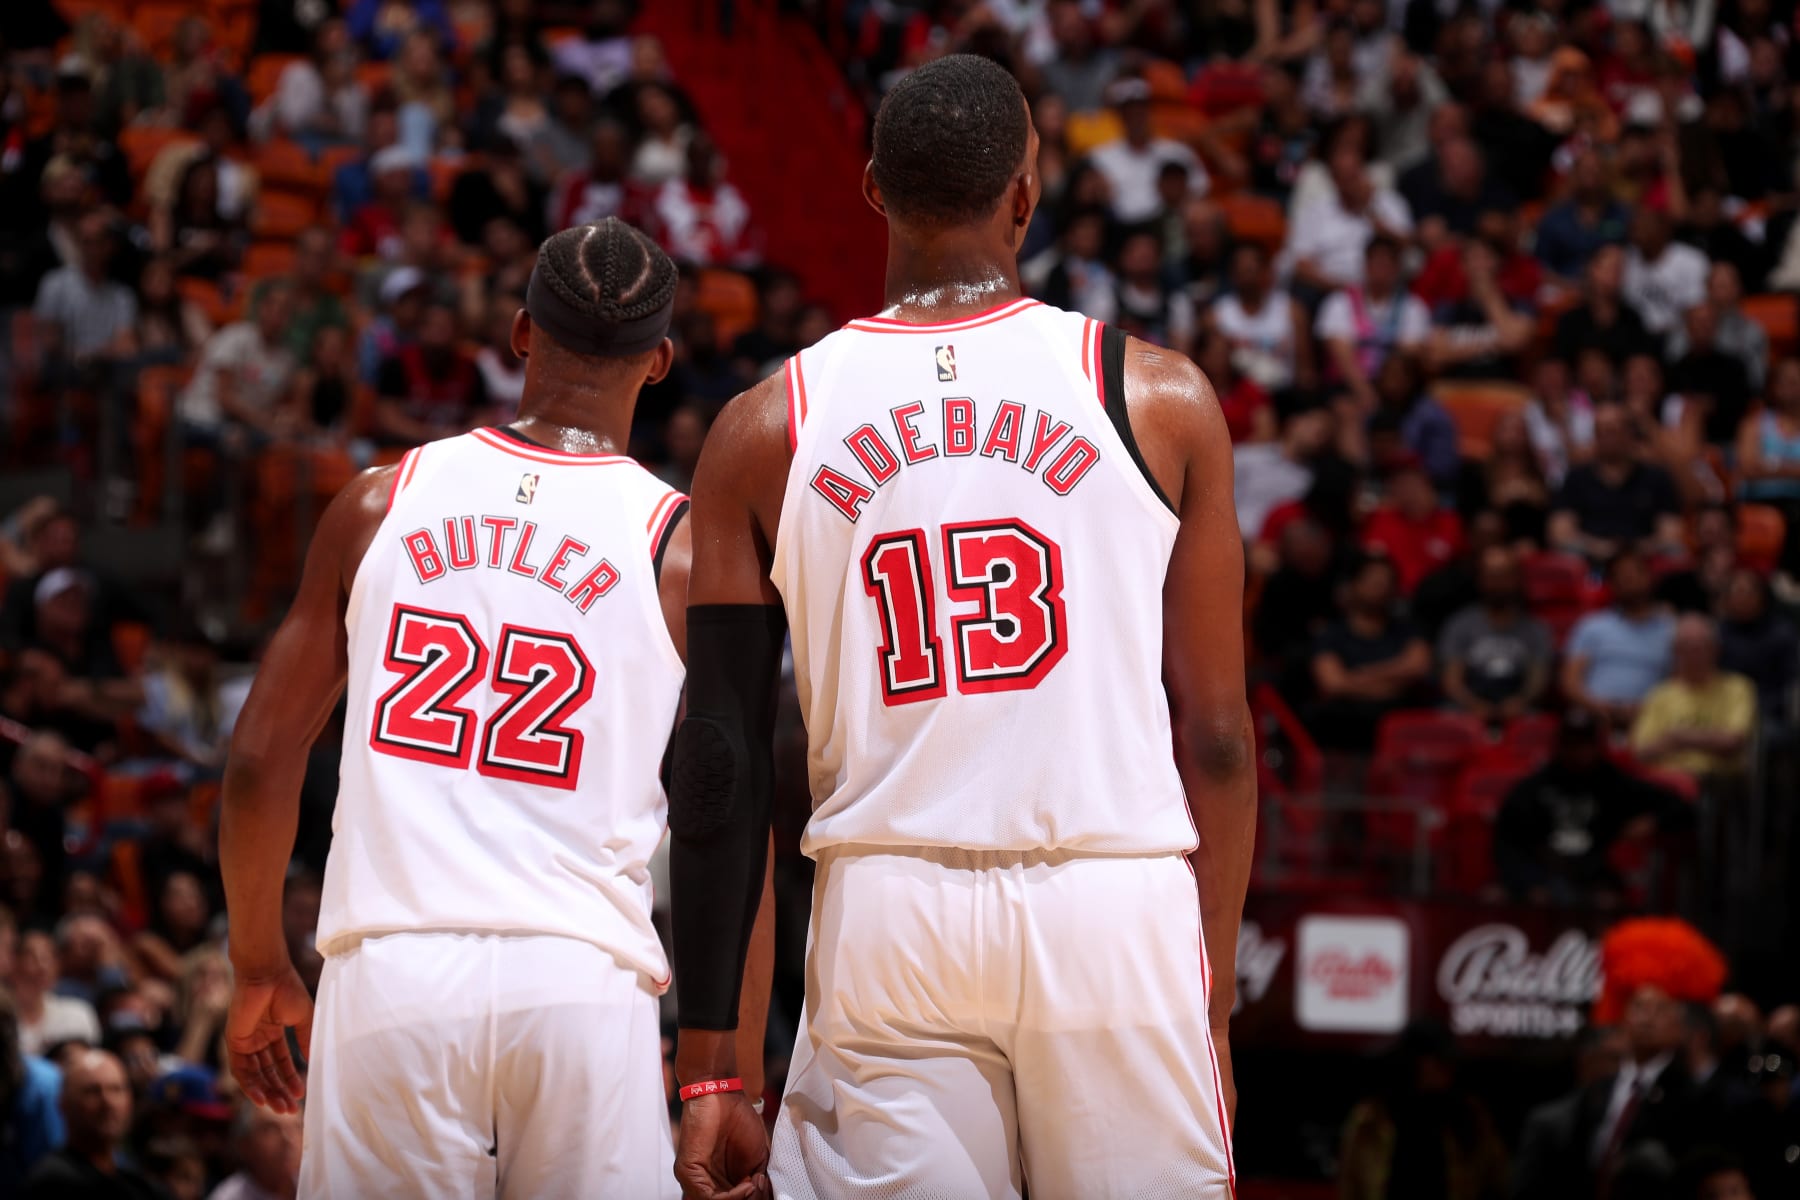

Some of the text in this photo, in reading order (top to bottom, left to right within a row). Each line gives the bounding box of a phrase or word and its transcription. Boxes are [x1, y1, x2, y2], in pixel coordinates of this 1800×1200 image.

[810, 397, 1100, 523] ADEBAYO
[401, 515, 620, 615] BUTLER
[860, 517, 1069, 707] 13
[369, 602, 597, 791] 22
[1436, 924, 1604, 1003] Ball
